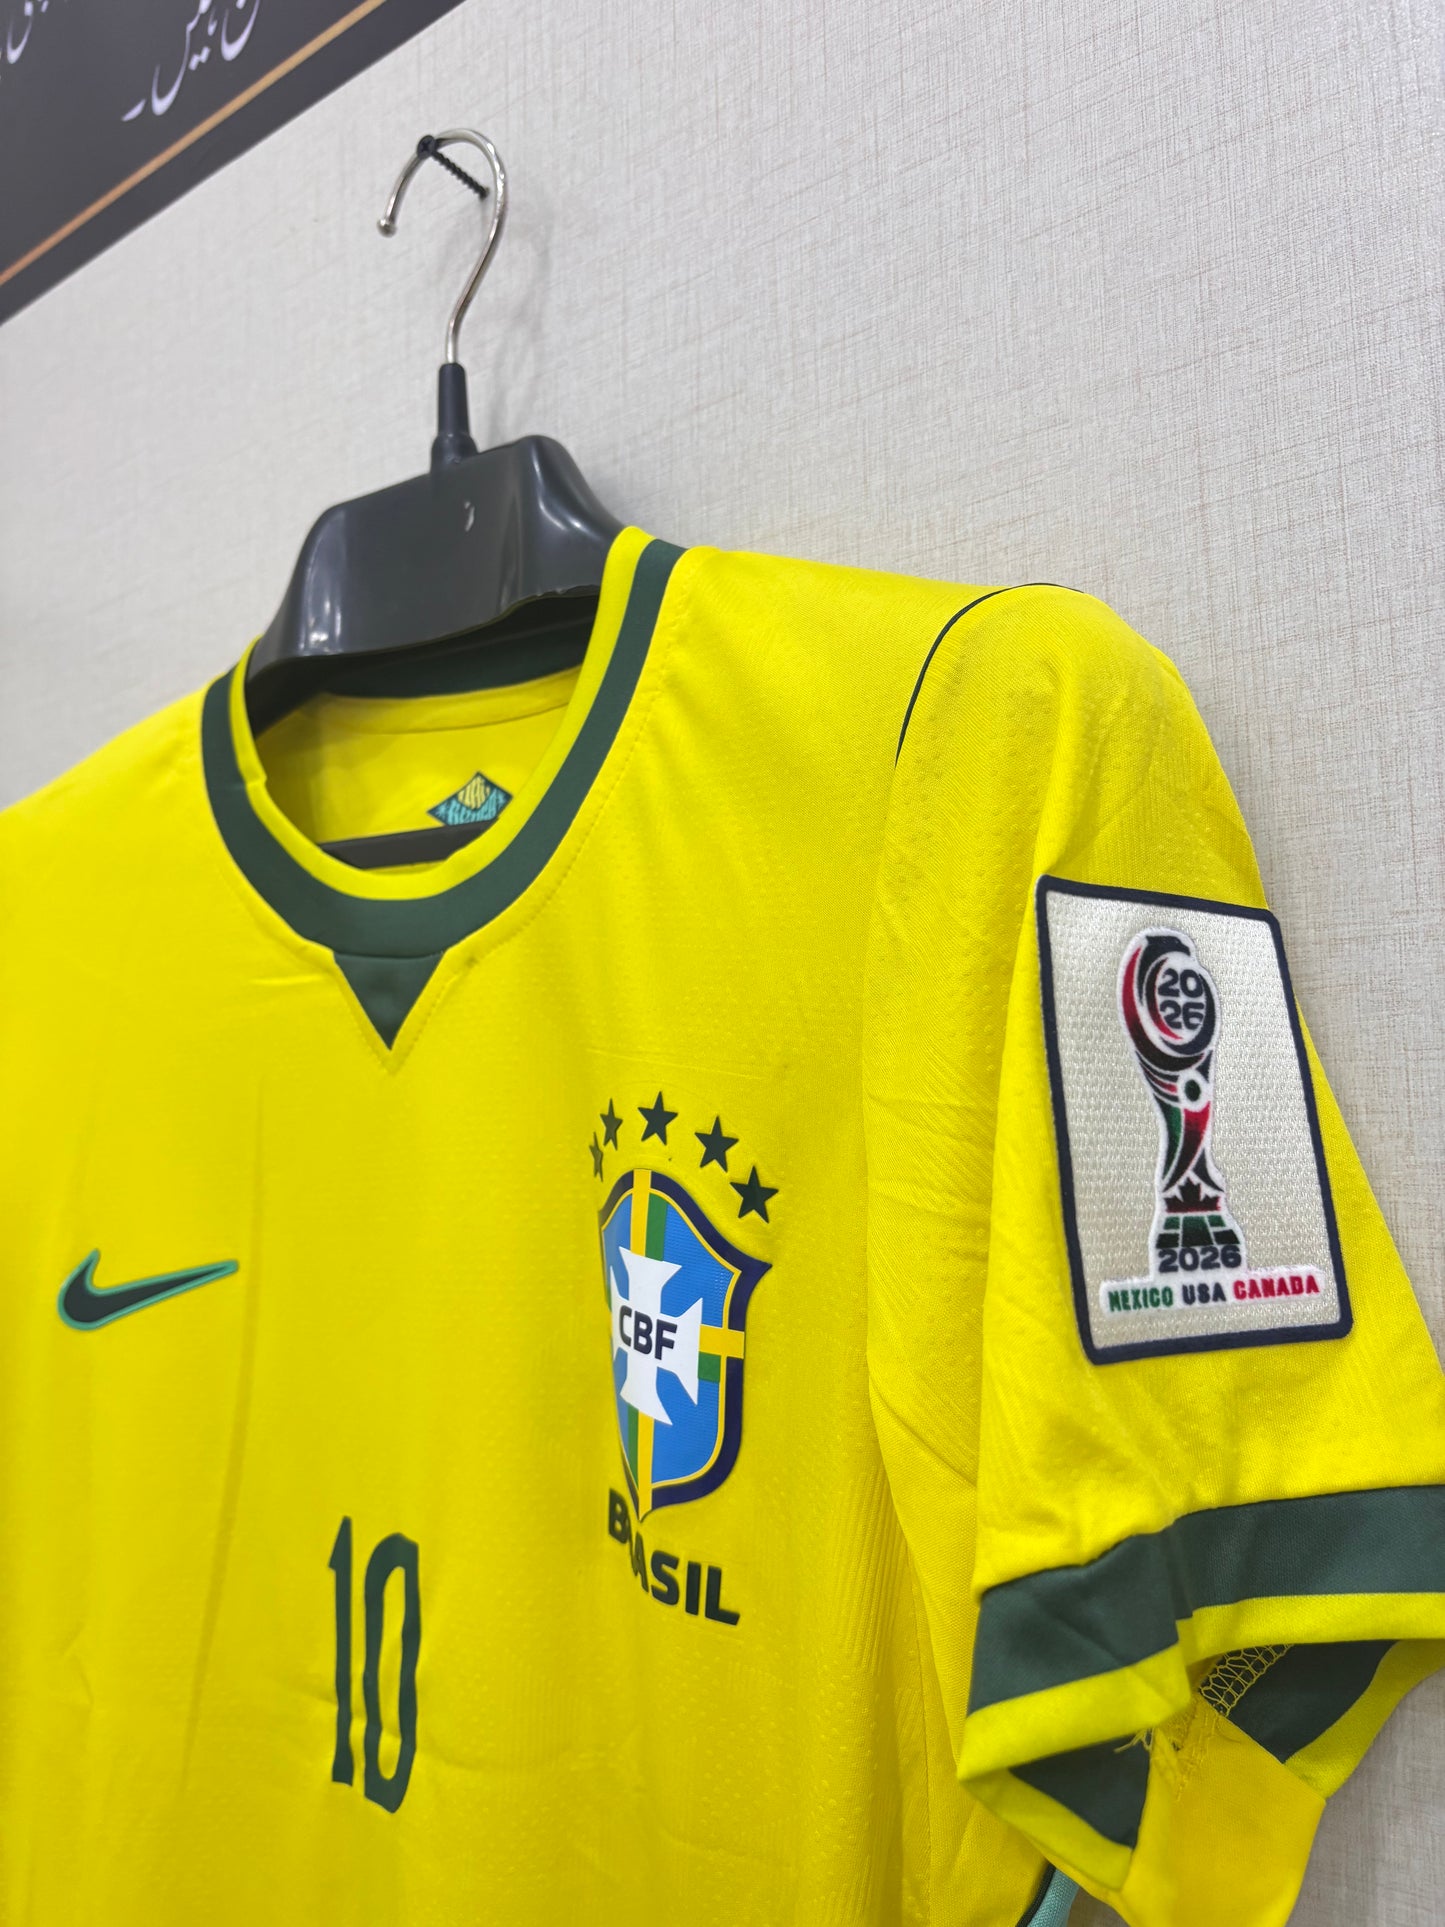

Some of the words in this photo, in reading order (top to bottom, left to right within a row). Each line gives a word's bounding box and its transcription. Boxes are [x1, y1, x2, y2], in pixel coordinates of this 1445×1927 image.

[1157, 967, 1204, 998] 20
[1159, 999, 1205, 1030] 26
[1158, 1245, 1242, 1273] 2026
[1107, 1286, 1174, 1312] MEXICO
[1181, 1282, 1227, 1305] USA
[1233, 1274, 1320, 1300] CANADA
[619, 1304, 678, 1361] CBF
[608, 1487, 741, 1627] BASIL
[328, 1515, 422, 1814] 10
